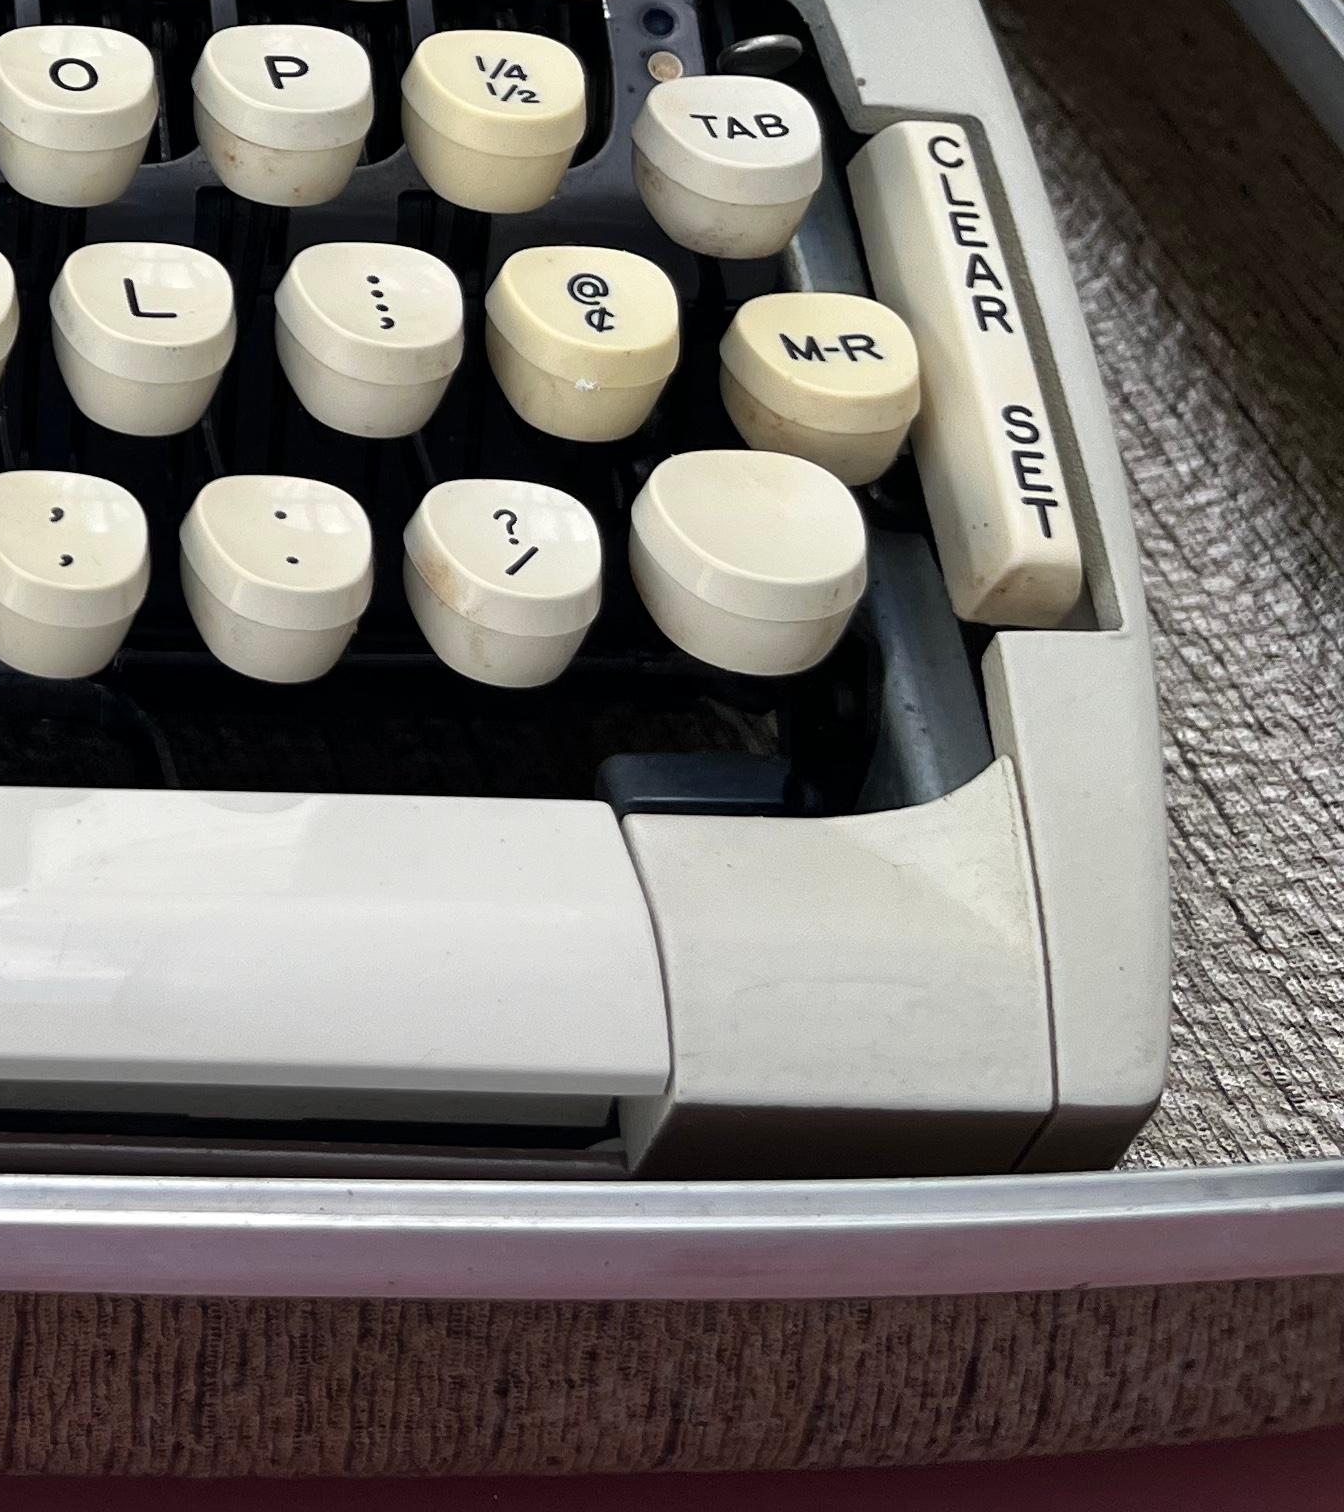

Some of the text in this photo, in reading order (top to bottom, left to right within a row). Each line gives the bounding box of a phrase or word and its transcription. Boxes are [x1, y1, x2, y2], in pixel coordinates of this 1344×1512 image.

[48, 57, 99, 92] O
[264, 55, 309, 90] P
[689, 113, 790, 140] TAB
[124, 279, 177, 318] L
[566, 273, 610, 306] @
[779, 333, 884, 362] M-R
[927, 134, 1061, 539] CLEAR SET
[493, 509, 520, 545] ?
[505, 546, 539, 576] /
